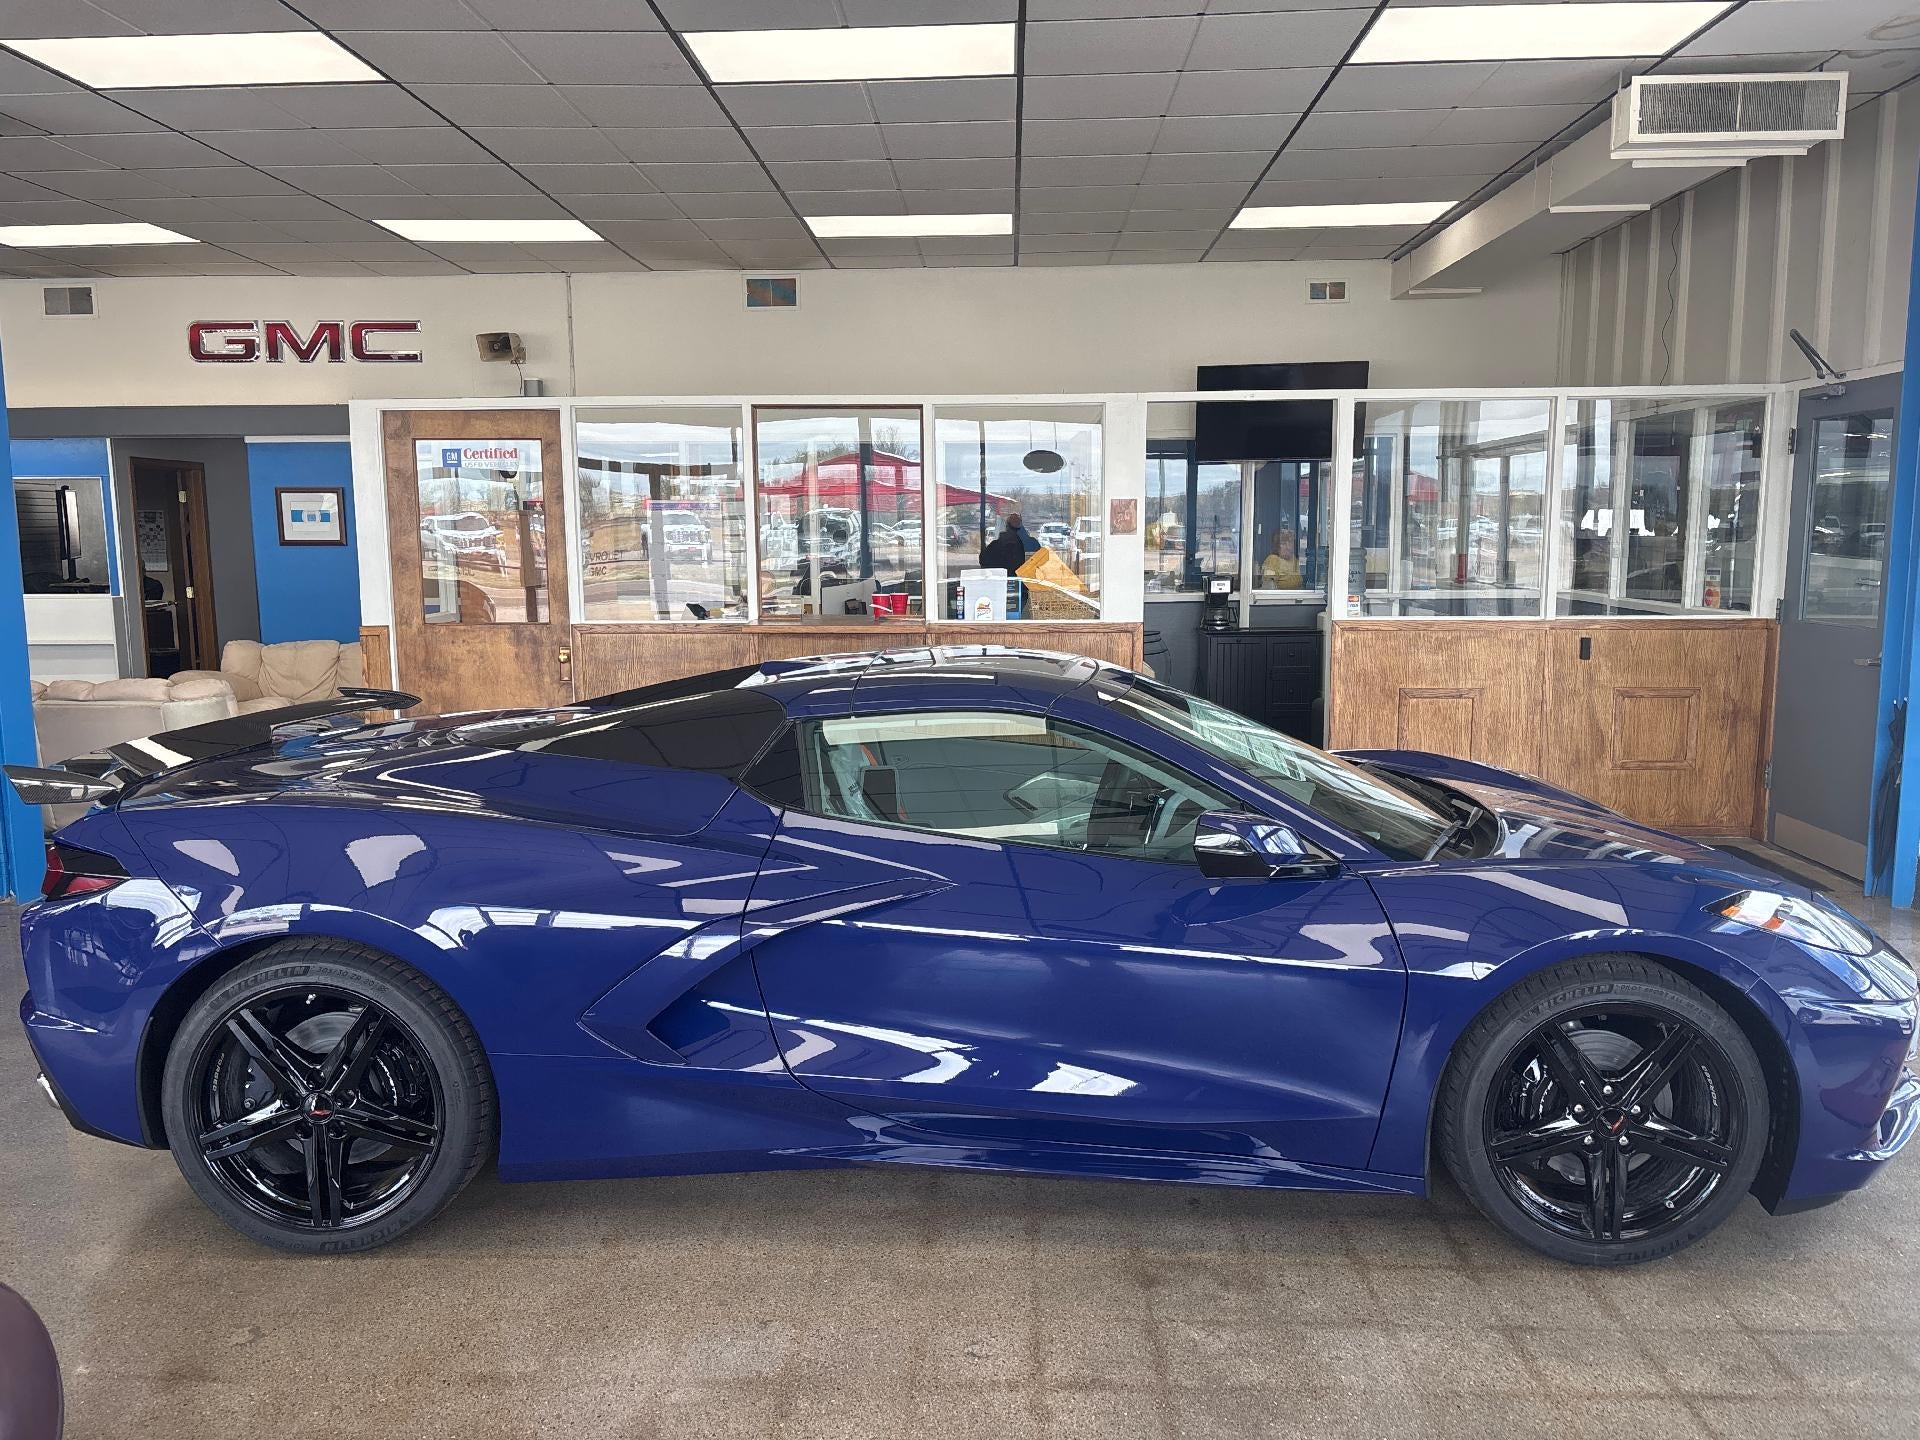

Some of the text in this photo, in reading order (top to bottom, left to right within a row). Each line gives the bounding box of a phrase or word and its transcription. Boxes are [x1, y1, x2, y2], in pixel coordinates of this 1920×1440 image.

[188, 319, 423, 363] GMC
[463, 448, 518, 460] Certified
[586, 551, 623, 561] VROLET
